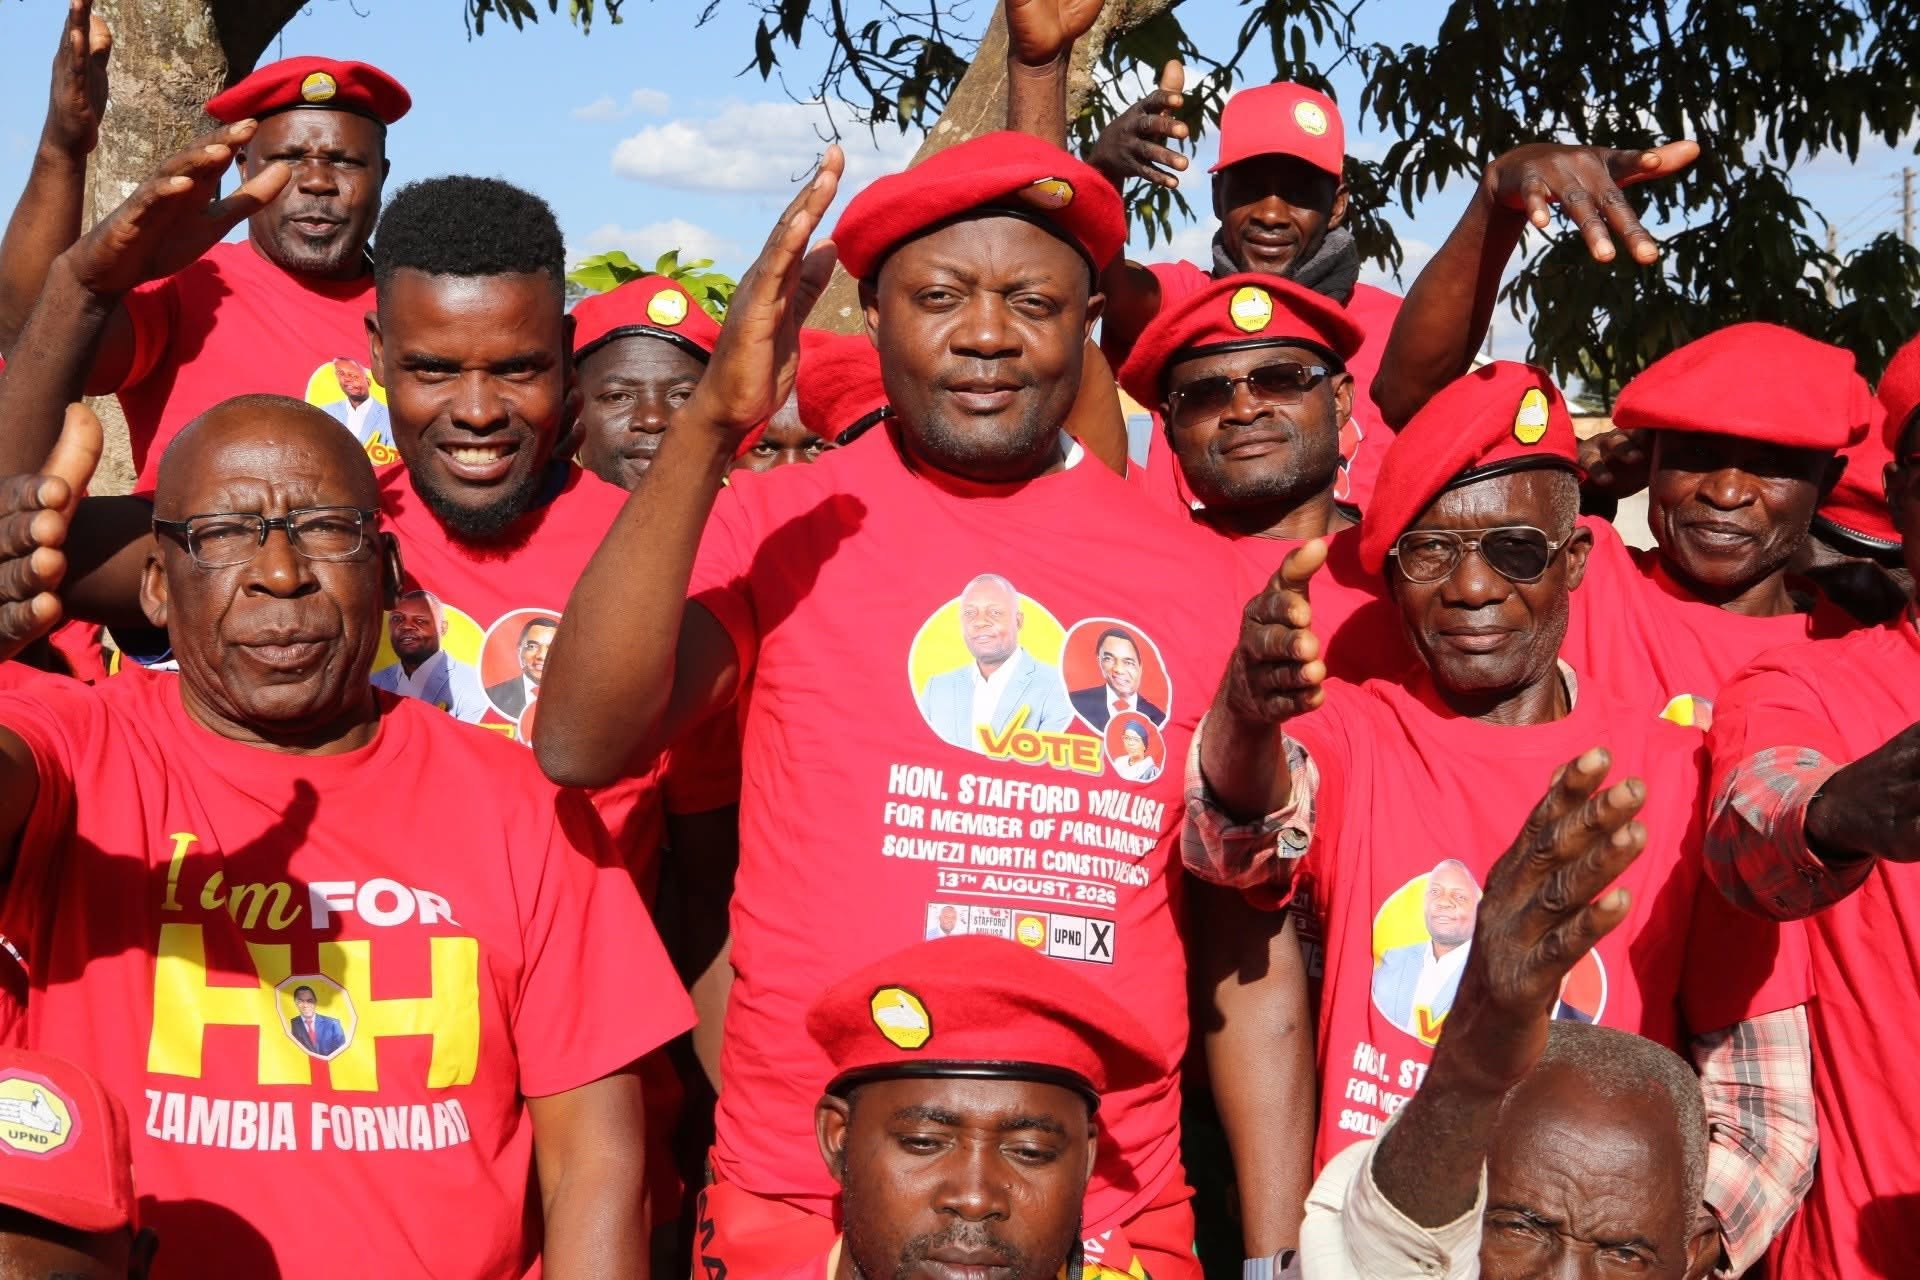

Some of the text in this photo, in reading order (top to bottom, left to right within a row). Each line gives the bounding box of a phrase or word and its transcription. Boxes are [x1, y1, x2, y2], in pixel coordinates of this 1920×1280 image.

[977, 705, 1103, 772] VOTE
[887, 764, 1165, 833] HON. STAFFORD MULUSA
[883, 802, 925, 829] FOR
[930, 808, 1023, 839] MEMBER
[1029, 818, 1057, 840] OF
[881, 834, 965, 864] SOLWEZI
[970, 843, 1037, 869] NORTH
[161, 832, 200, 912] I
[308, 877, 463, 930] FOR
[937, 872, 1117, 905] 13TH AUGUST, 2026
[973, 915, 1007, 928] STAFFORD
[1055, 927, 1082, 947] UPND
[7, 1130, 49, 1145] UPND
[145, 1088, 472, 1152] ZAMBIA FORWARD
